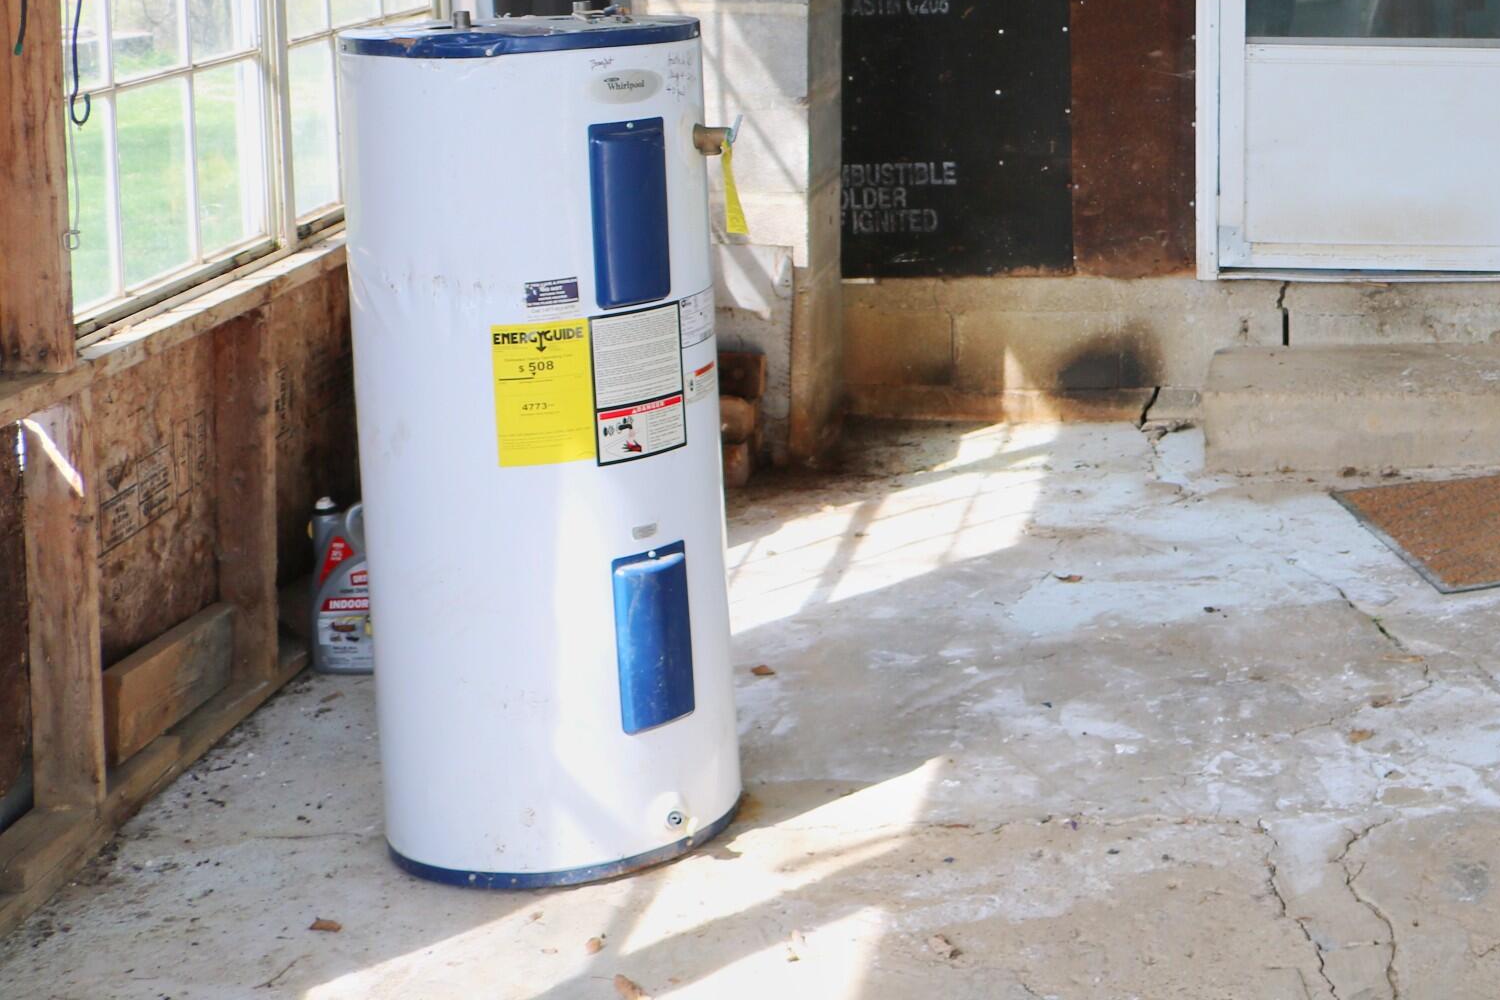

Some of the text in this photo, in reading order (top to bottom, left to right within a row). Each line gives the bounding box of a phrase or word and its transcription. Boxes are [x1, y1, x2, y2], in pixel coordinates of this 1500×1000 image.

[607, 79, 645, 92] Whirlpool
[852, 209, 938, 234] IGNITED
[528, 360, 554, 373] 508
[521, 402, 548, 411] 4773
